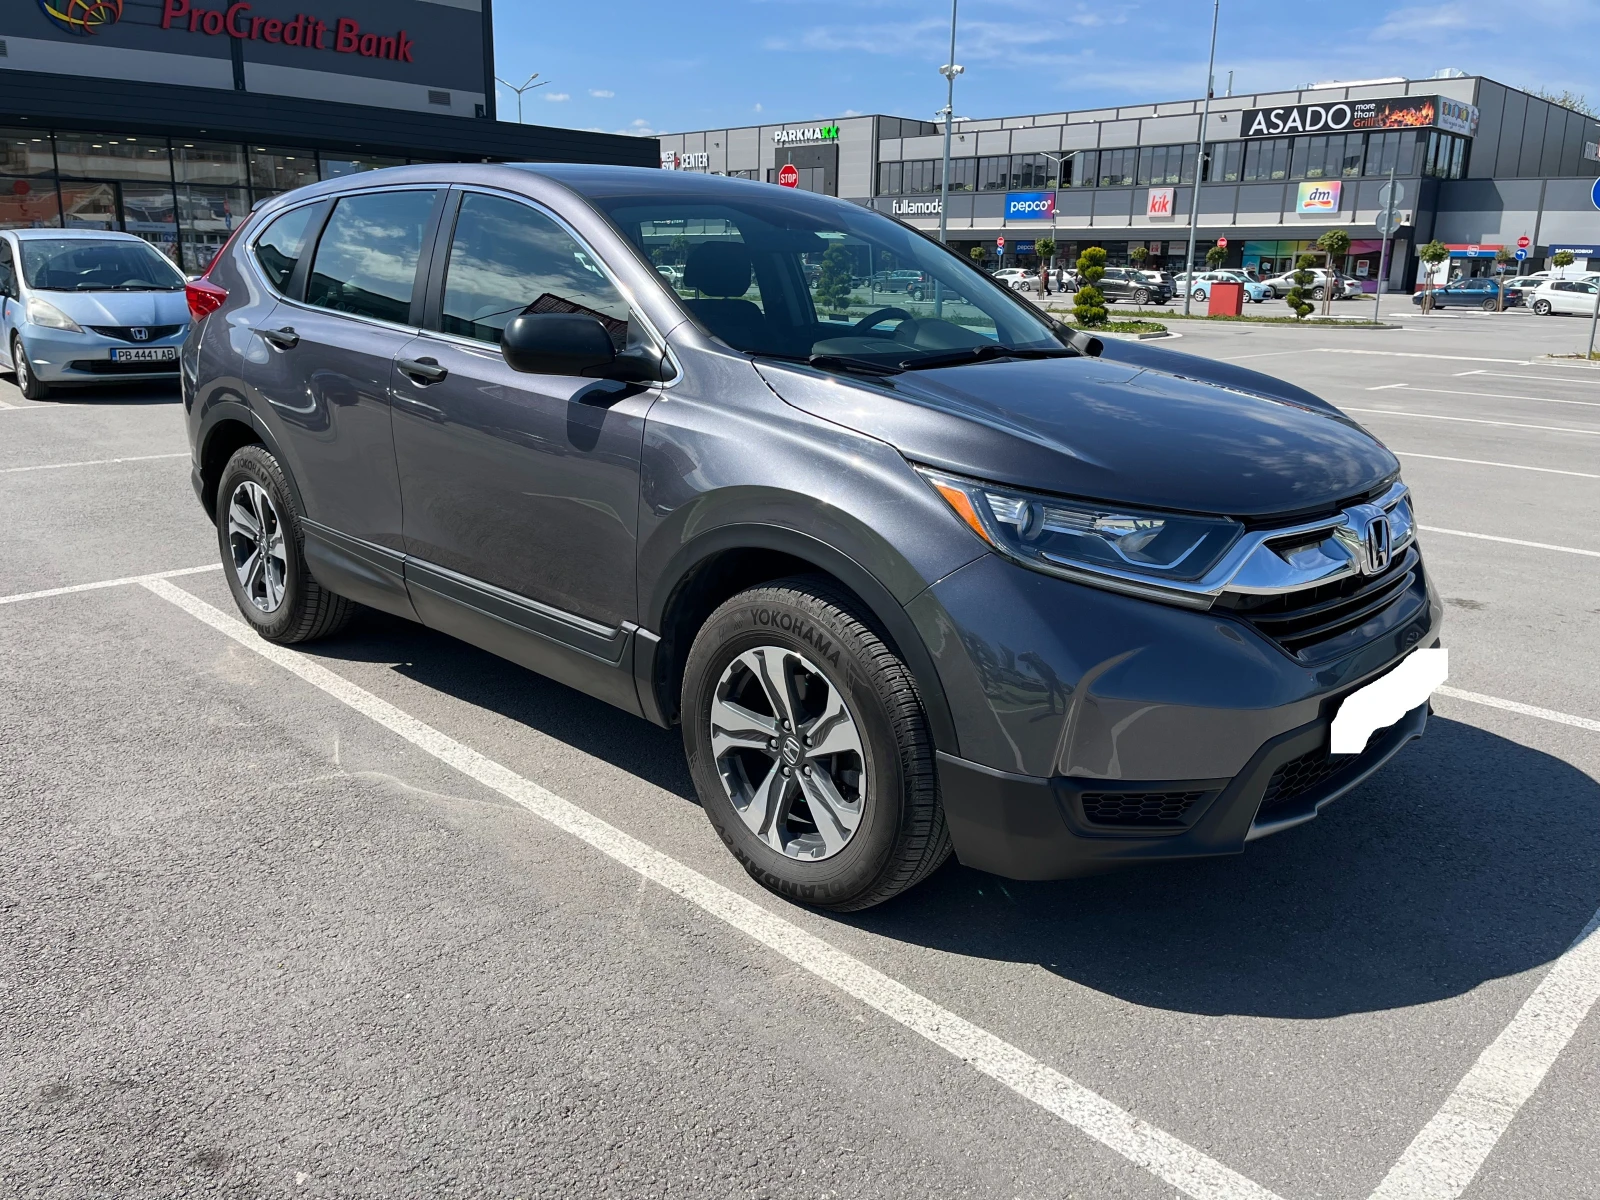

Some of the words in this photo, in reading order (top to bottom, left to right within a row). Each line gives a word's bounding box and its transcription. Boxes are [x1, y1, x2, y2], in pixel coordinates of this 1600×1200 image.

[162, 0, 327, 49] ProCredit
[336, 18, 414, 62] Bank
[1248, 104, 1352, 135] ASADO
[1353, 118, 1374, 128] Grill
[1354, 111, 1375, 119] than
[774, 126, 839, 143] PARKMAXX
[681, 152, 708, 168] CENTER
[780, 173, 797, 184] STOP
[1309, 188, 1330, 201] dm
[892, 198, 942, 214] fullamoda
[1010, 199, 1049, 213] pepco
[118, 350, 132, 361] PB
[134, 350, 158, 361] 4441
[161, 349, 174, 360] AB
[236, 457, 271, 493] YOKOHAMA
[750, 608, 841, 669] YOKOHAMA
